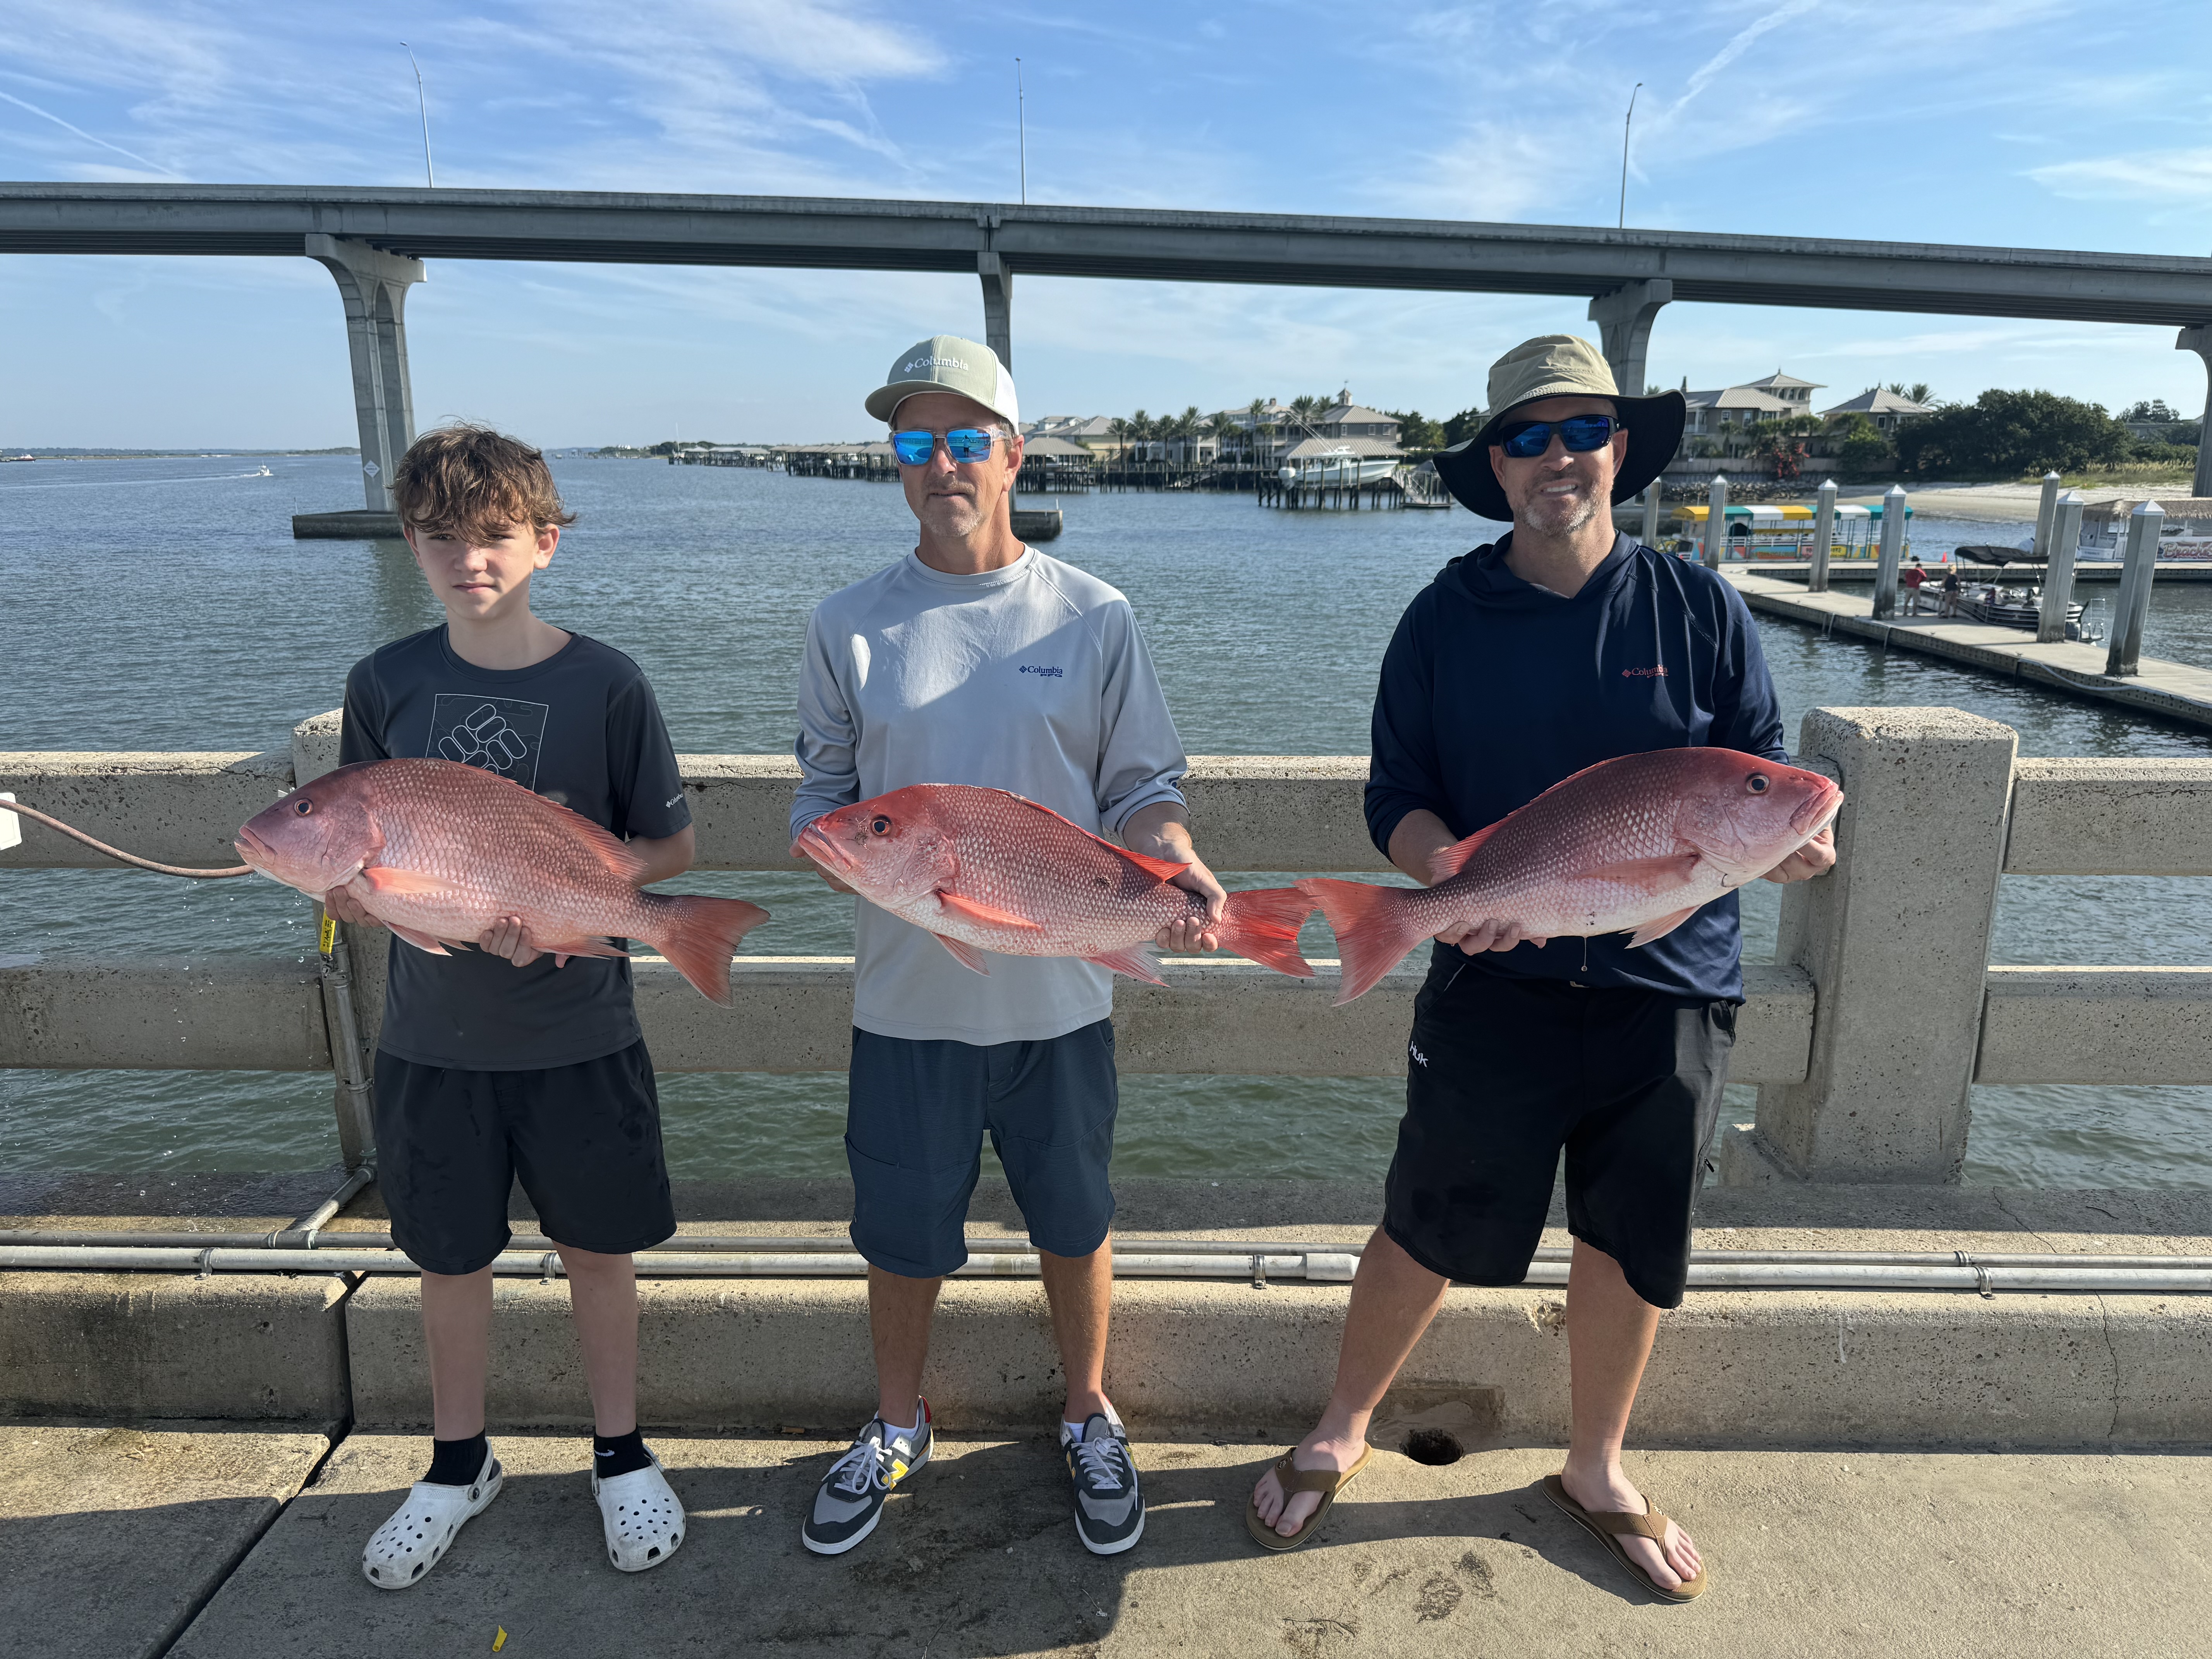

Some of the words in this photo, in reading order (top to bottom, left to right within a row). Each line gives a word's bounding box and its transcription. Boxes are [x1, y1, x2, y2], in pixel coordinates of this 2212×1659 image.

[914, 356, 969, 371] Columbia
[1027, 666, 1063, 674] Columbia
[1632, 664, 1668, 676] Columbia
[1409, 1041, 1429, 1068] HUK
